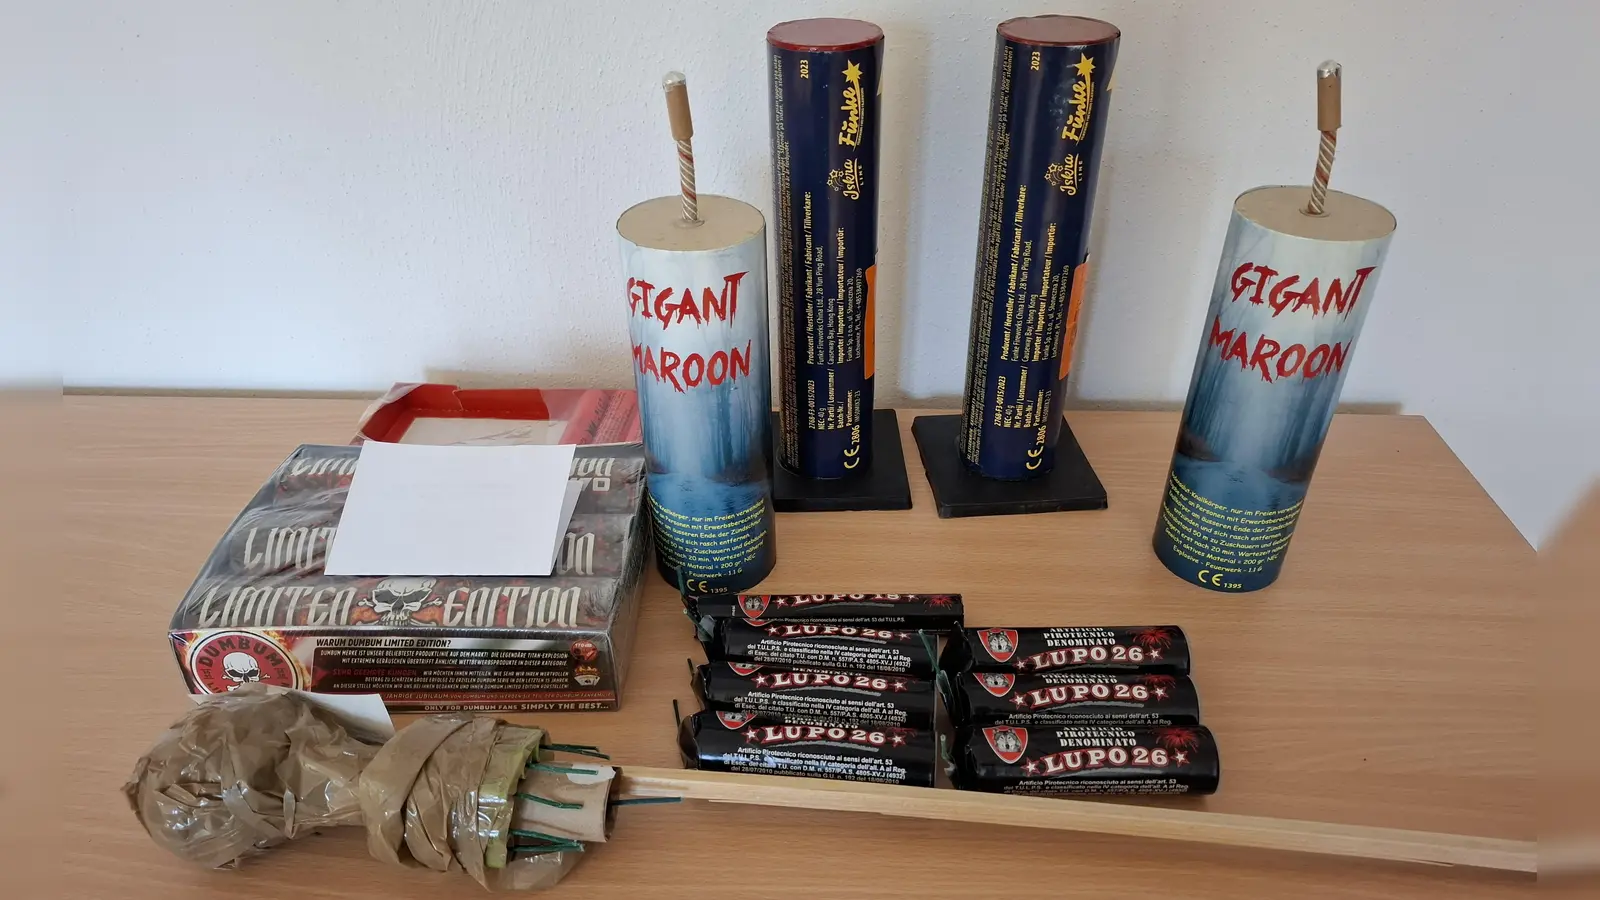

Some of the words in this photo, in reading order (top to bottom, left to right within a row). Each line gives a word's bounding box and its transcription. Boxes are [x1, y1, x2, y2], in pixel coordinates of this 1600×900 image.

[799, 59, 809, 79] 2023
[1030, 51, 1041, 70] 2023
[803, 191, 812, 229] Tillverkare:
[1015, 184, 1027, 223] Tillverkare:
[836, 227, 846, 259] Importör:
[1011, 228, 1023, 259] Fabricant
[1044, 222, 1057, 254] Importör:
[804, 234, 812, 265] Fabricant
[815, 245, 824, 262] Road,
[1023, 240, 1033, 257] Road,
[815, 263, 825, 276] Ping
[1021, 257, 1032, 271] Ping
[805, 269, 813, 298] Fabrikant
[816, 276, 824, 287] Yun
[836, 263, 846, 300] Importateur
[1007, 262, 1019, 293] Fabrikant
[1020, 271, 1029, 282] Yun
[1040, 259, 1052, 297] Importateur
[816, 287, 824, 295] 28
[1019, 282, 1028, 290] 28
[1230, 262, 1378, 322] GIGANT
[626, 270, 750, 331] GIGANT
[827, 298, 835, 312] Kong
[1018, 291, 1027, 303] Ltd.,
[1028, 294, 1039, 308] Kong
[806, 302, 814, 332] Hersteller
[816, 308, 824, 324] China
[836, 305, 846, 335] Importeur
[1004, 296, 1015, 327] Hersteller
[1016, 304, 1025, 319] China
[1026, 309, 1038, 324] Hong
[1034, 301, 1046, 332] Importeur
[827, 313, 836, 328] Hong
[816, 324, 824, 349] Fireworks
[1013, 320, 1023, 346] Fireworks
[806, 336, 814, 364] Producent
[827, 340, 836, 365] Causeway
[836, 338, 846, 364] Importer
[1000, 330, 1012, 361] Producent
[1011, 346, 1020, 362] Funke
[1021, 336, 1032, 362] Causeway
[1031, 336, 1043, 362] Importer
[1208, 314, 1352, 384] MAROON
[818, 418, 826, 430] NEC:
[851, 424, 860, 445] 2806
[714, 513, 736, 521] Freien
[1196, 503, 1225, 520] Personen
[1200, 525, 1213, 533] und
[1213, 530, 1228, 538] sich
[1233, 525, 1251, 533] Ende
[693, 547, 731, 555] Zuschauern
[1194, 540, 1210, 550] nach
[1220, 540, 1260, 549] Zuschauern
[720, 561, 734, 569] 200
[1205, 561, 1242, 573] Feuerwerk
[1206, 553, 1237, 564] Material
[688, 570, 723, 578] Feuerwerk
[1198, 569, 1223, 587] CE
[1223, 582, 1242, 590] 1395
[785, 624, 857, 635] LUPO
[862, 628, 892, 639] 26
[1043, 631, 1115, 639] PIROTECNICO
[316, 638, 346, 647] WARUM
[349, 638, 382, 648] DUMBUM
[383, 639, 415, 648] LIMITED
[415, 639, 452, 648] EDITION?
[783, 640, 814, 649] Pirotecnico
[814, 643, 849, 651] riconosciuto
[1047, 638, 1116, 647] DENOMINATO
[198, 637, 282, 668] DUMBUM
[788, 647, 819, 655] classificato
[841, 651, 867, 659] categoria
[1033, 646, 1107, 670] LUPO
[1112, 646, 1143, 661] 26
[774, 673, 850, 686] LUPO
[855, 676, 887, 690] 26
[771, 692, 804, 701] Pirotecnico
[804, 696, 840, 704] riconosciuto
[1031, 684, 1109, 706] LUPO
[1114, 684, 1148, 699] 26
[765, 726, 846, 741] LUPO
[852, 729, 885, 744] 26
[1056, 730, 1136, 739] PIROTECNICO
[1060, 738, 1137, 747] DENOMINATO
[797, 753, 836, 761] riconosciuto
[1045, 747, 1127, 773] LUPO
[1133, 748, 1168, 765] 26
